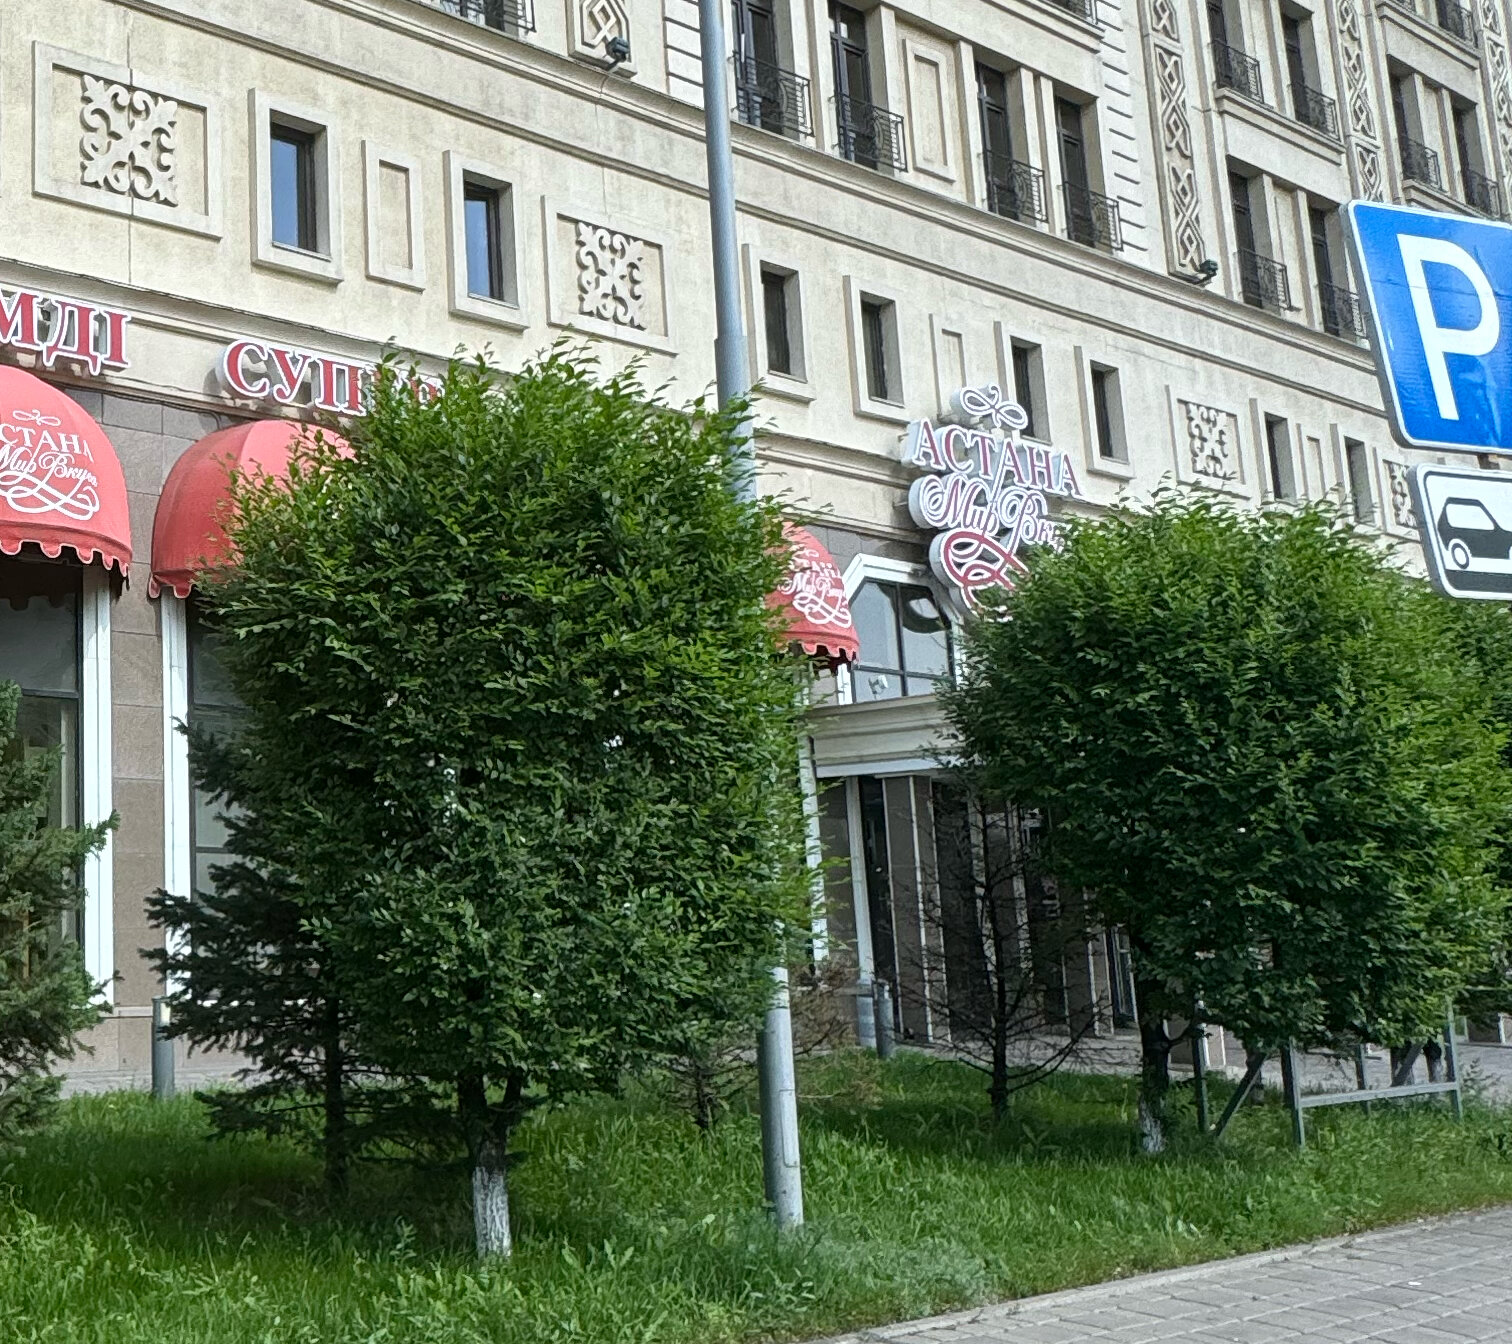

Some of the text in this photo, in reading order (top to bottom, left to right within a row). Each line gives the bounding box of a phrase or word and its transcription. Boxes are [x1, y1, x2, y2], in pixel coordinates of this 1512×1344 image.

[1397, 233, 1500, 421] P
[912, 418, 1085, 500] АСТАНА
[919, 474, 1001, 538] Мир
